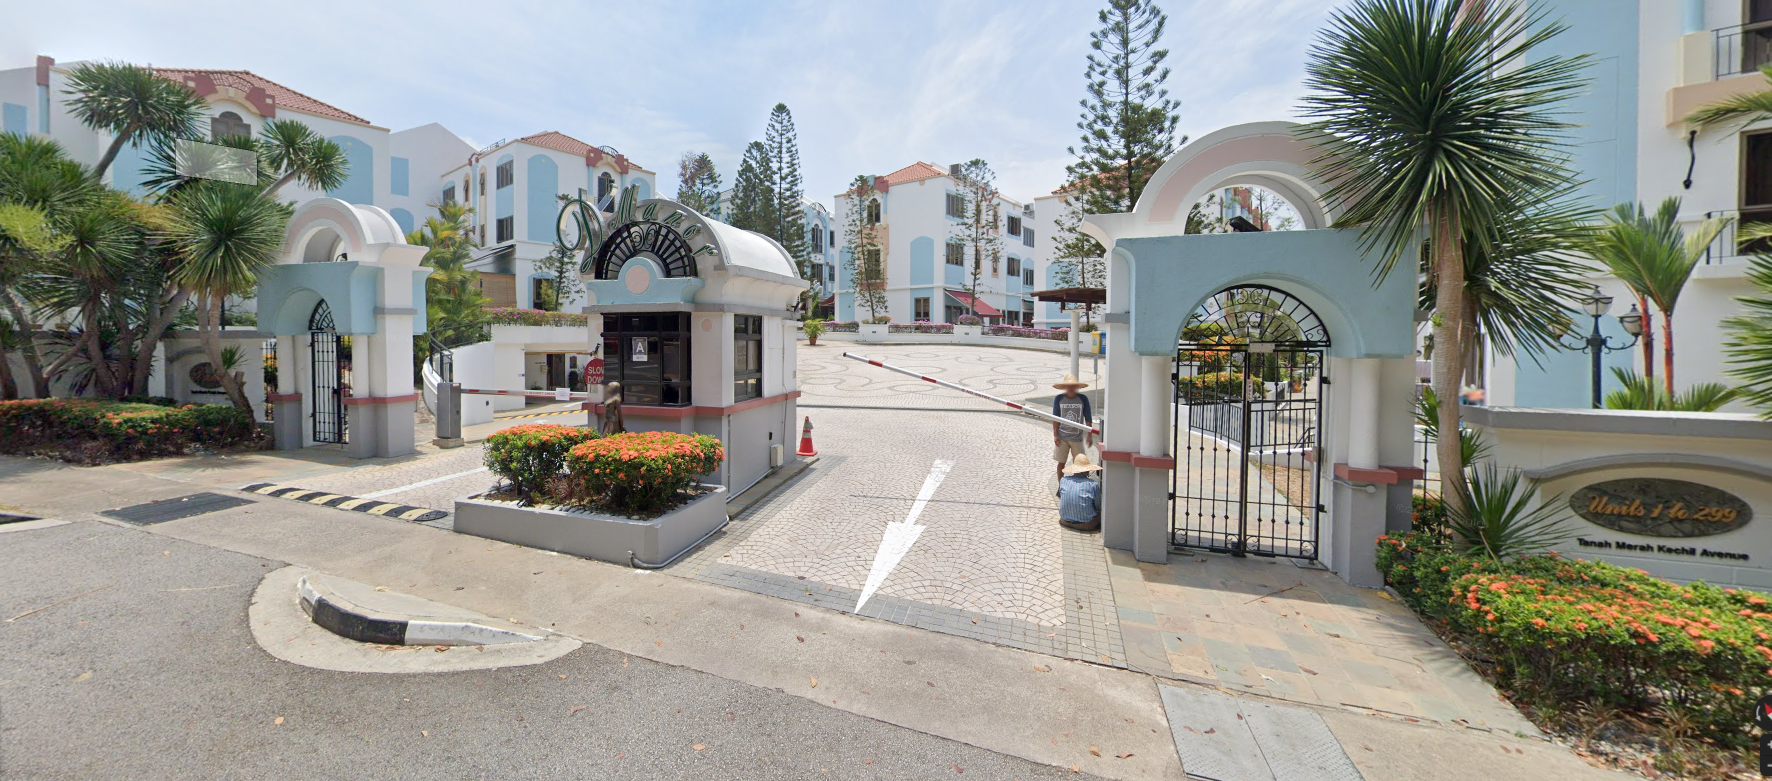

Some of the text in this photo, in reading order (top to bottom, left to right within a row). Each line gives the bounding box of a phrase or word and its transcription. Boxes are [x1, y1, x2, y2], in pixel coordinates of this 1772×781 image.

[636, 342, 644, 352] A
[1586, 494, 1738, 523] Units 1 to 299
[1576, 538, 1750, 561] Tanah Merah Kechil Avenue
